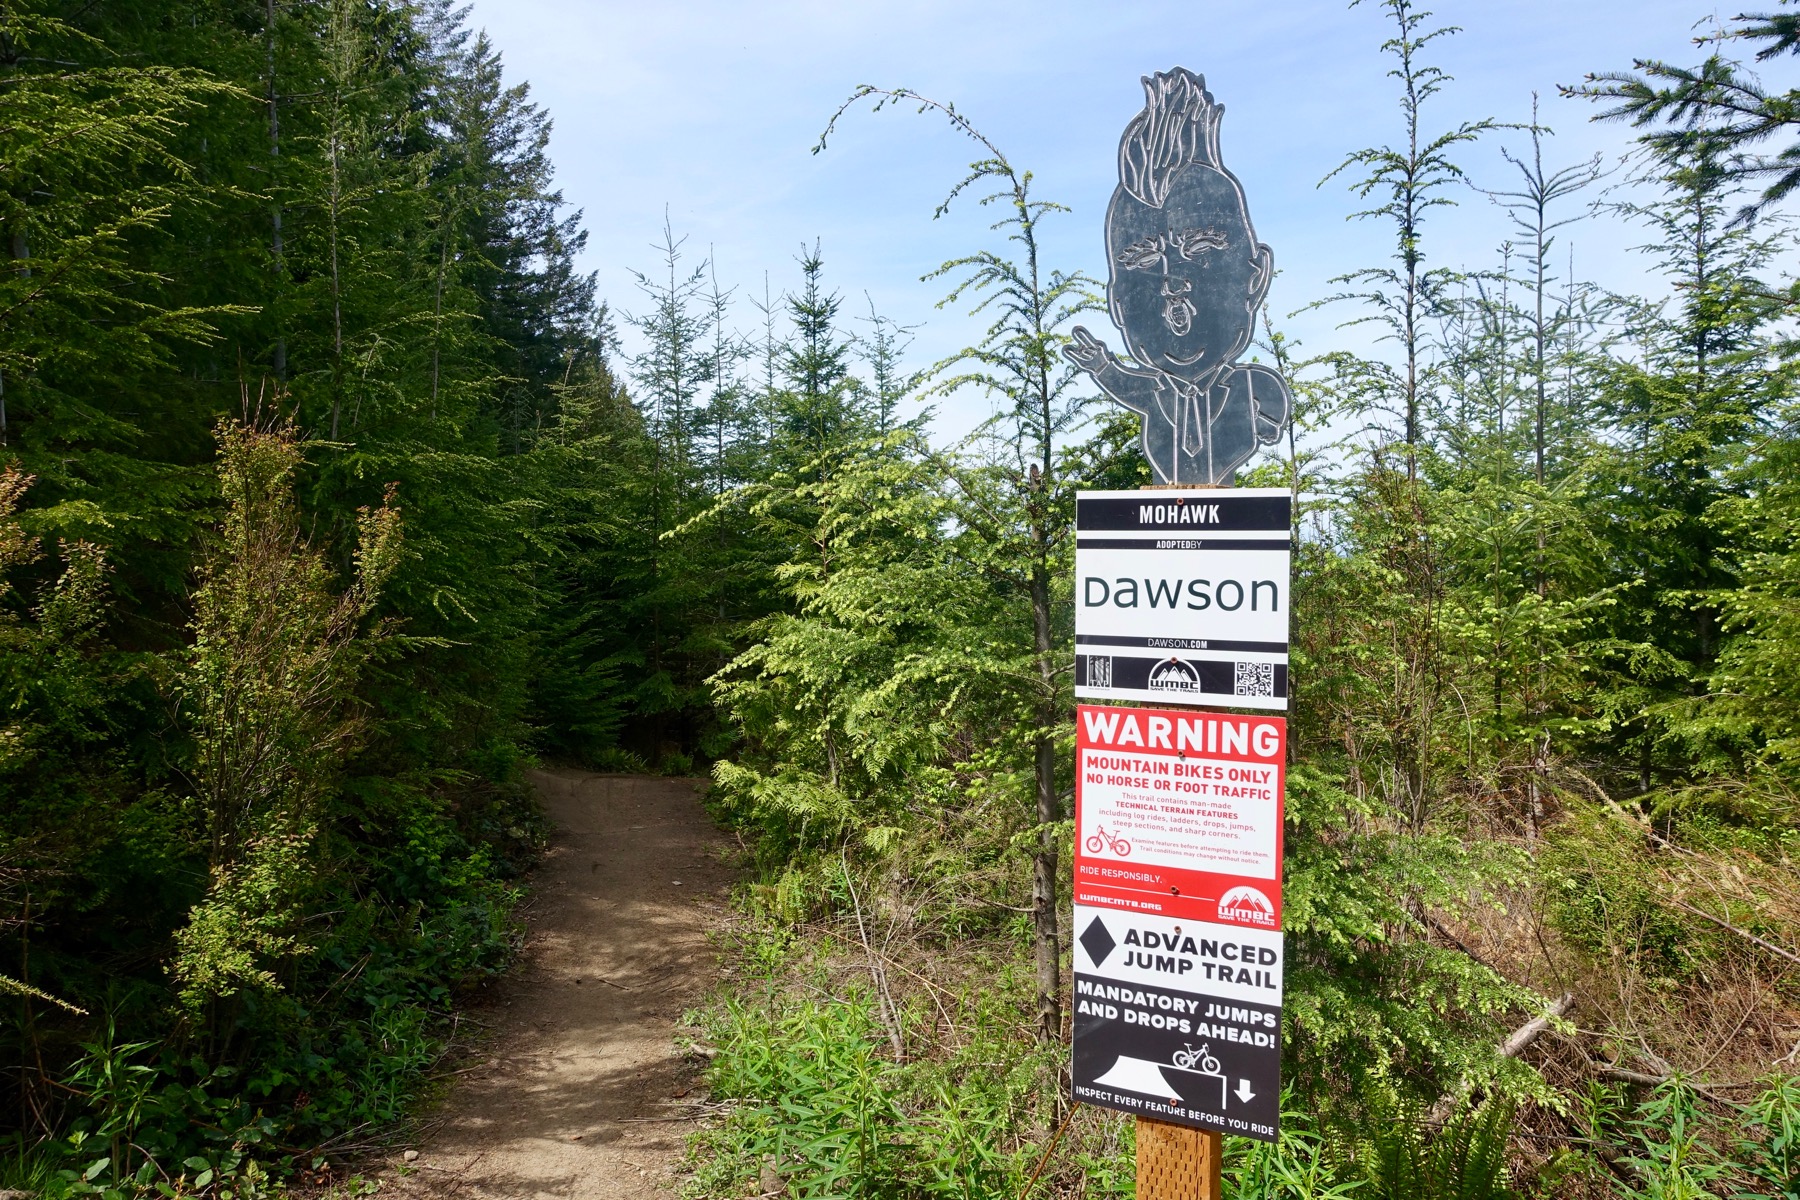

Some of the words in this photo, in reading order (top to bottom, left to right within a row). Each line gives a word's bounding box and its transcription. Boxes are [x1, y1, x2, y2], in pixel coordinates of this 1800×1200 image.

[1139, 505, 1220, 523] MOHAWK
[1085, 577, 1278, 612] Dawson
[1148, 638, 1207, 649] DAWSON.COM
[1083, 711, 1279, 757] WARNING
[1087, 756, 1169, 775] MOUNTAIN
[1174, 763, 1224, 780] BIKES
[1228, 768, 1271, 784] ONLY
[1086, 773, 1103, 784] NO
[1107, 774, 1149, 788] HORSE
[1154, 779, 1170, 791] OR
[1175, 781, 1209, 795] FOOT
[1213, 784, 1271, 800] TRAFFIC
[1115, 801, 1158, 811] TECHNICAL
[1161, 805, 1194, 815] TERRAIN
[1197, 809, 1238, 819] FEATURES
[1122, 792, 1137, 800] This
[1139, 794, 1154, 802] trail
[1157, 796, 1188, 805] contains
[1190, 800, 1232, 809] man-made
[1099, 808, 1131, 819] including
[1134, 812, 1145, 820] log
[1147, 814, 1168, 823] rides,
[1170, 816, 1201, 826] ladders,
[1203, 820, 1227, 829] drops,
[1229, 822, 1256, 832] jumps,
[1112, 820, 1132, 828] steep
[1134, 823, 1167, 832] sections,
[1185, 827, 1206, 836] sharp
[1208, 831, 1240, 839] corners.
[1132, 837, 1154, 845] Examine
[1156, 840, 1179, 848] features
[1200, 846, 1231, 854] attempting
[1154, 847, 1182, 855] conditions
[1080, 865, 1099, 875] RIDE
[1102, 868, 1162, 884] RESPONSIBLY.
[1124, 928, 1277, 966] ADVANCED
[1123, 951, 1193, 975] JUMP
[1202, 962, 1277, 989] TRAIL
[1078, 980, 1199, 1014] MANDATORY
[1205, 1003, 1276, 1028] JUMPS
[1078, 1000, 1118, 1019] AND
[1124, 1009, 1191, 1033] DROPS
[1196, 1023, 1275, 1049] AHEAD!
[1075, 1085, 1111, 1102] INSPECT
[1114, 1094, 1143, 1107] EVERY
[1145, 1101, 1186, 1117] FEATURE
[1189, 1110, 1225, 1126] BEFORE
[1228, 1118, 1248, 1130] YOU
[1252, 1122, 1274, 1136] RIDE
